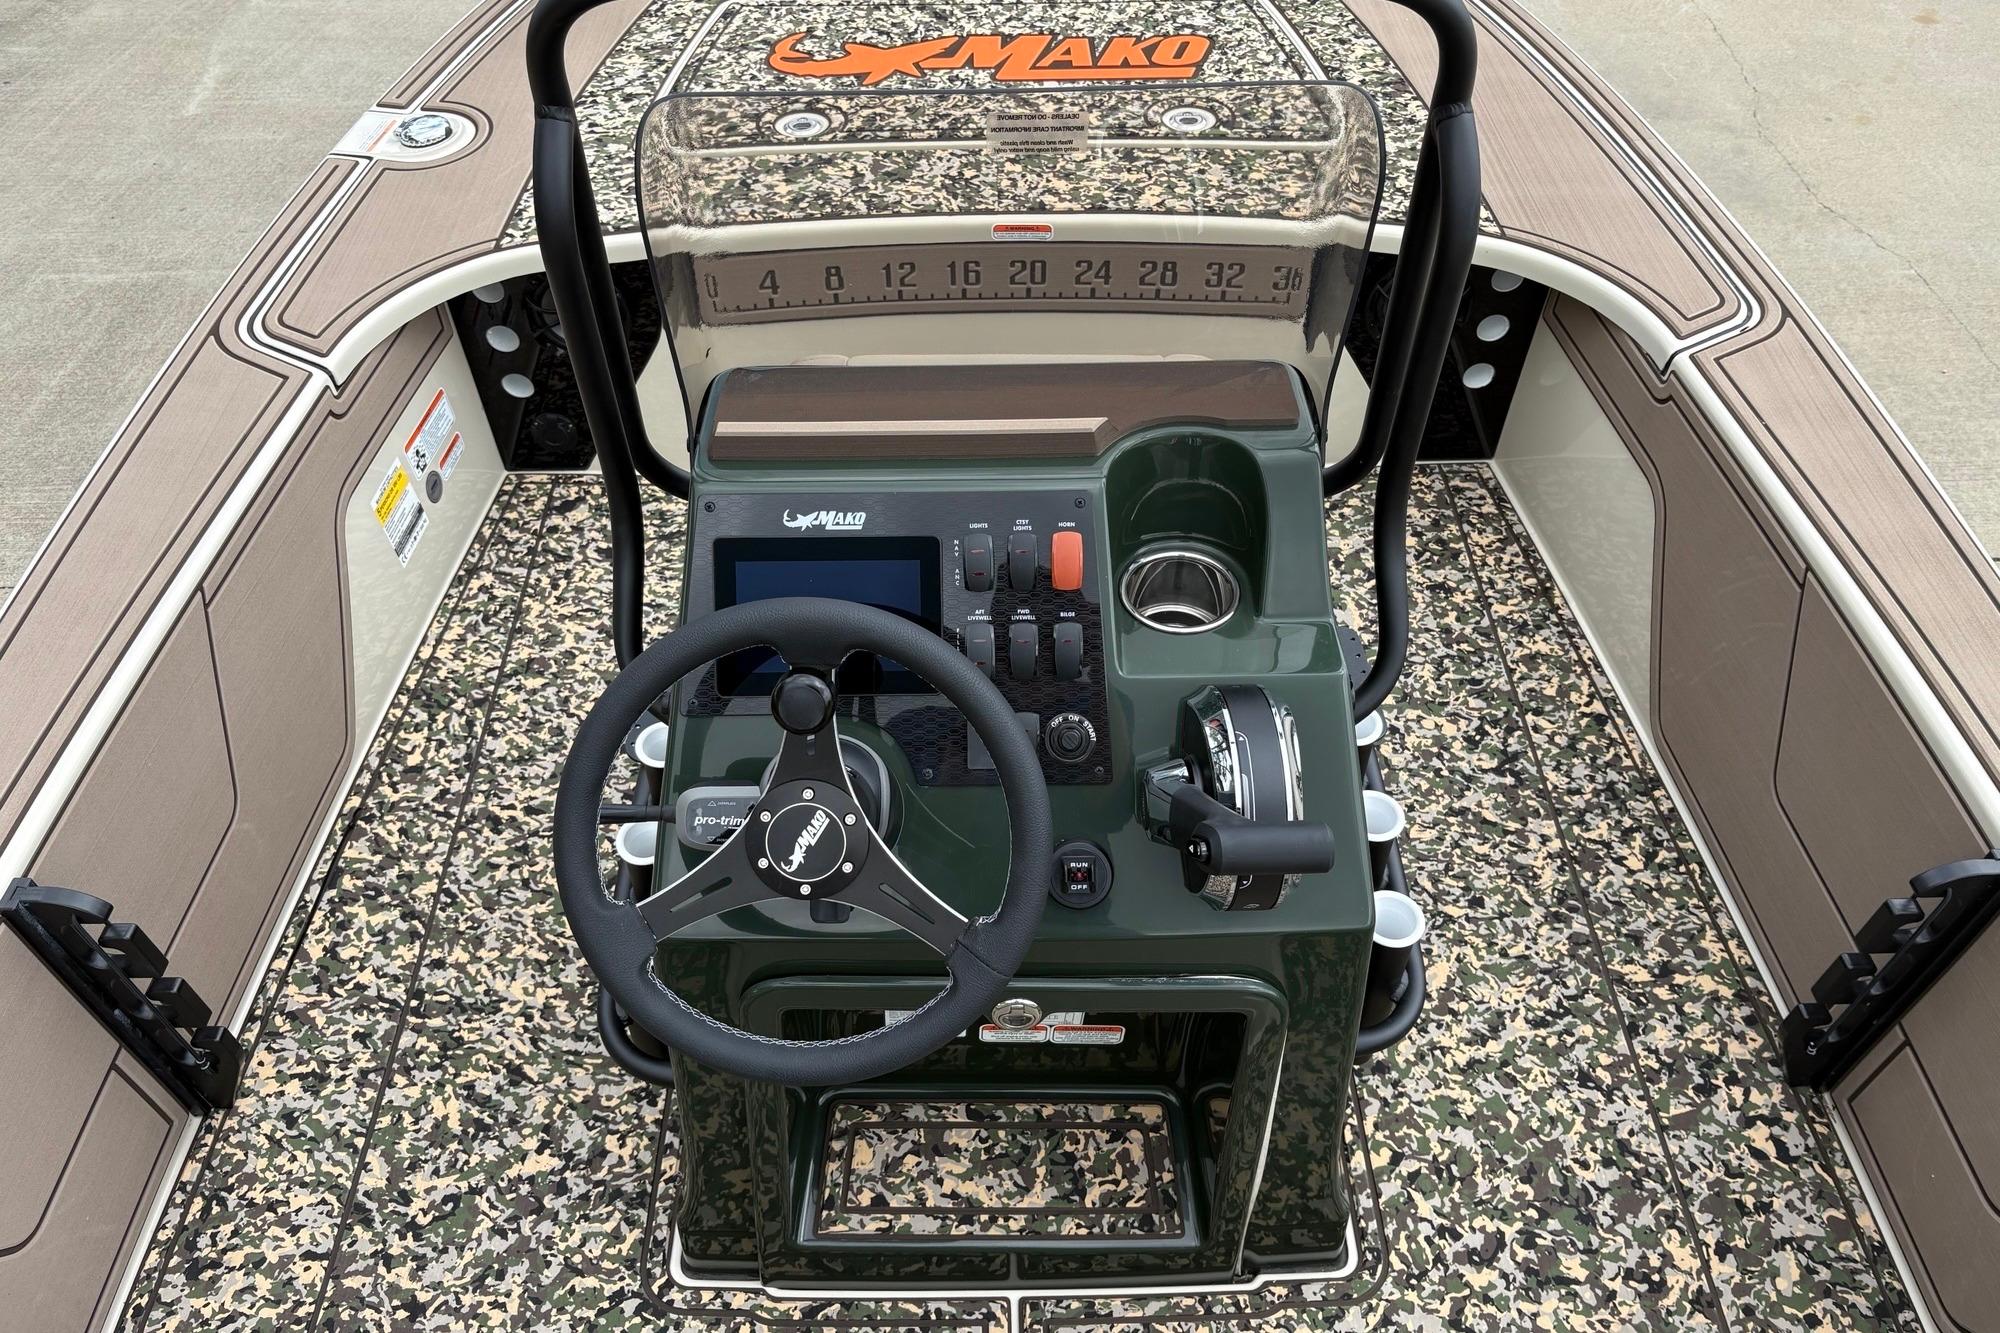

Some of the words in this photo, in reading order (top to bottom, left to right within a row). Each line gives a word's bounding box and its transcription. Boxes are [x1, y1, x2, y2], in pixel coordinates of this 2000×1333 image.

[920, 34, 1212, 80] MAKO
[758, 269, 780, 295] 4
[824, 265, 845, 291] 8
[881, 262, 917, 288] 12
[946, 260, 982, 287] 16
[1009, 259, 1047, 286] 20
[1074, 259, 1112, 286] 24
[1138, 260, 1178, 287] 28
[1204, 262, 1246, 288] 32
[1271, 265, 1304, 292] 36
[811, 510, 867, 531] MAKO
[1050, 715, 1064, 728] OFF
[1068, 714, 1080, 722] ON
[1082, 720, 1097, 742] START
[694, 815, 745, 827] pro-trim
[796, 809, 831, 853] MAKO
